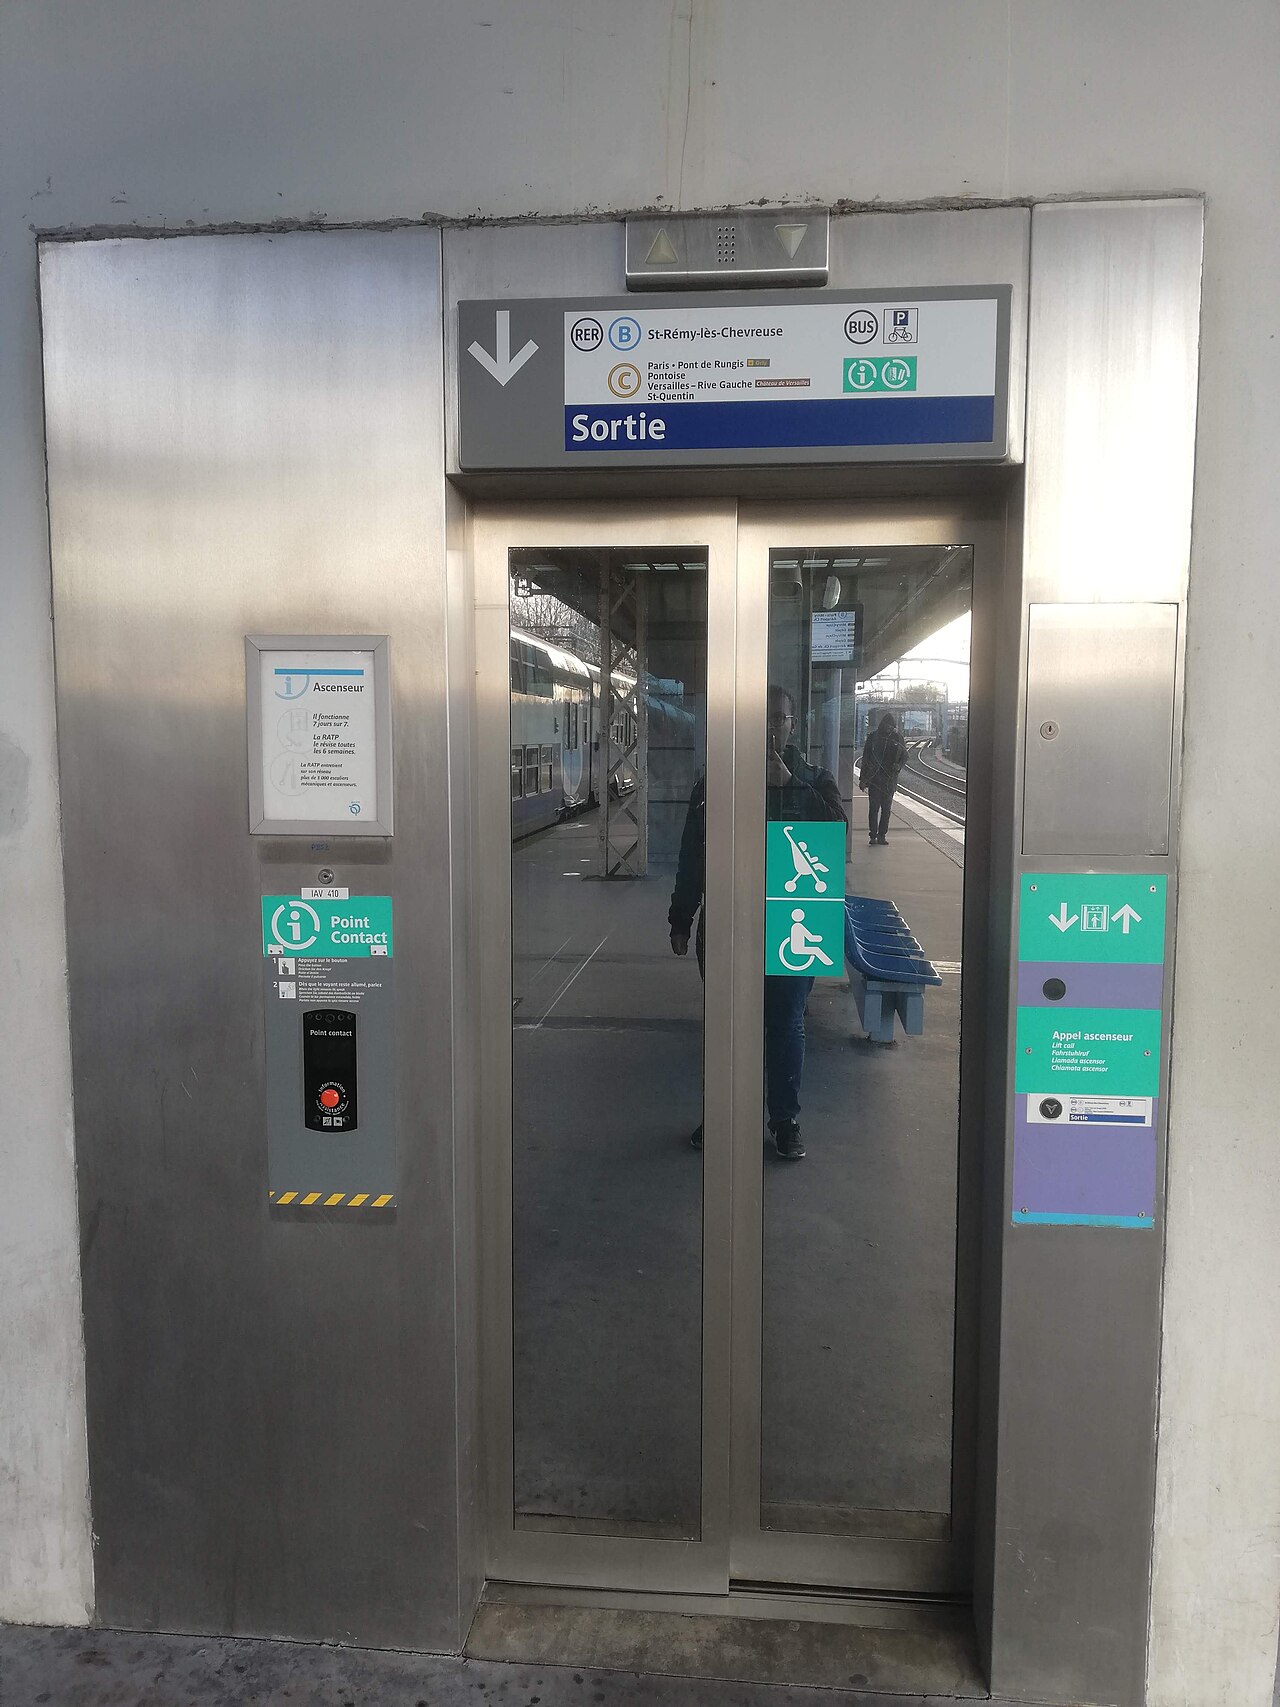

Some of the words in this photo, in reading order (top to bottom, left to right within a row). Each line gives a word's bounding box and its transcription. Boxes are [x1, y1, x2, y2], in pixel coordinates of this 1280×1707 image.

[896, 311, 906, 325] P
[849, 320, 874, 334] BUS
[575, 328, 599, 341] RER
[618, 325, 632, 343] B
[647, 326, 783, 342] St-Rémy-lès-Chevreuse
[647, 361, 670, 370] Paris
[678, 361, 699, 369] Pont
[700, 360, 712, 369] de
[714, 359, 744, 370] Rungis
[618, 371, 632, 390] C
[647, 371, 686, 380] Pontoise
[647, 381, 690, 390] Versailles
[697, 380, 717, 390] Rive
[719, 380, 752, 389] Gauche
[647, 391, 695, 402] St-Quentin
[572, 411, 666, 441] Sortie
[313, 682, 365, 693] Ascenseur
[313, 713, 319, 721] Il
[317, 713, 350, 721] fonctionne
[311, 890, 323, 898] IAV
[327, 890, 339, 898] 410
[330, 915, 370, 929] Point
[330, 930, 387, 944] Contact
[1052, 1031, 1081, 1041] Appel
[1083, 1033, 1134, 1041] ascenseur
[1051, 1064, 1081, 1072] Chiamata
